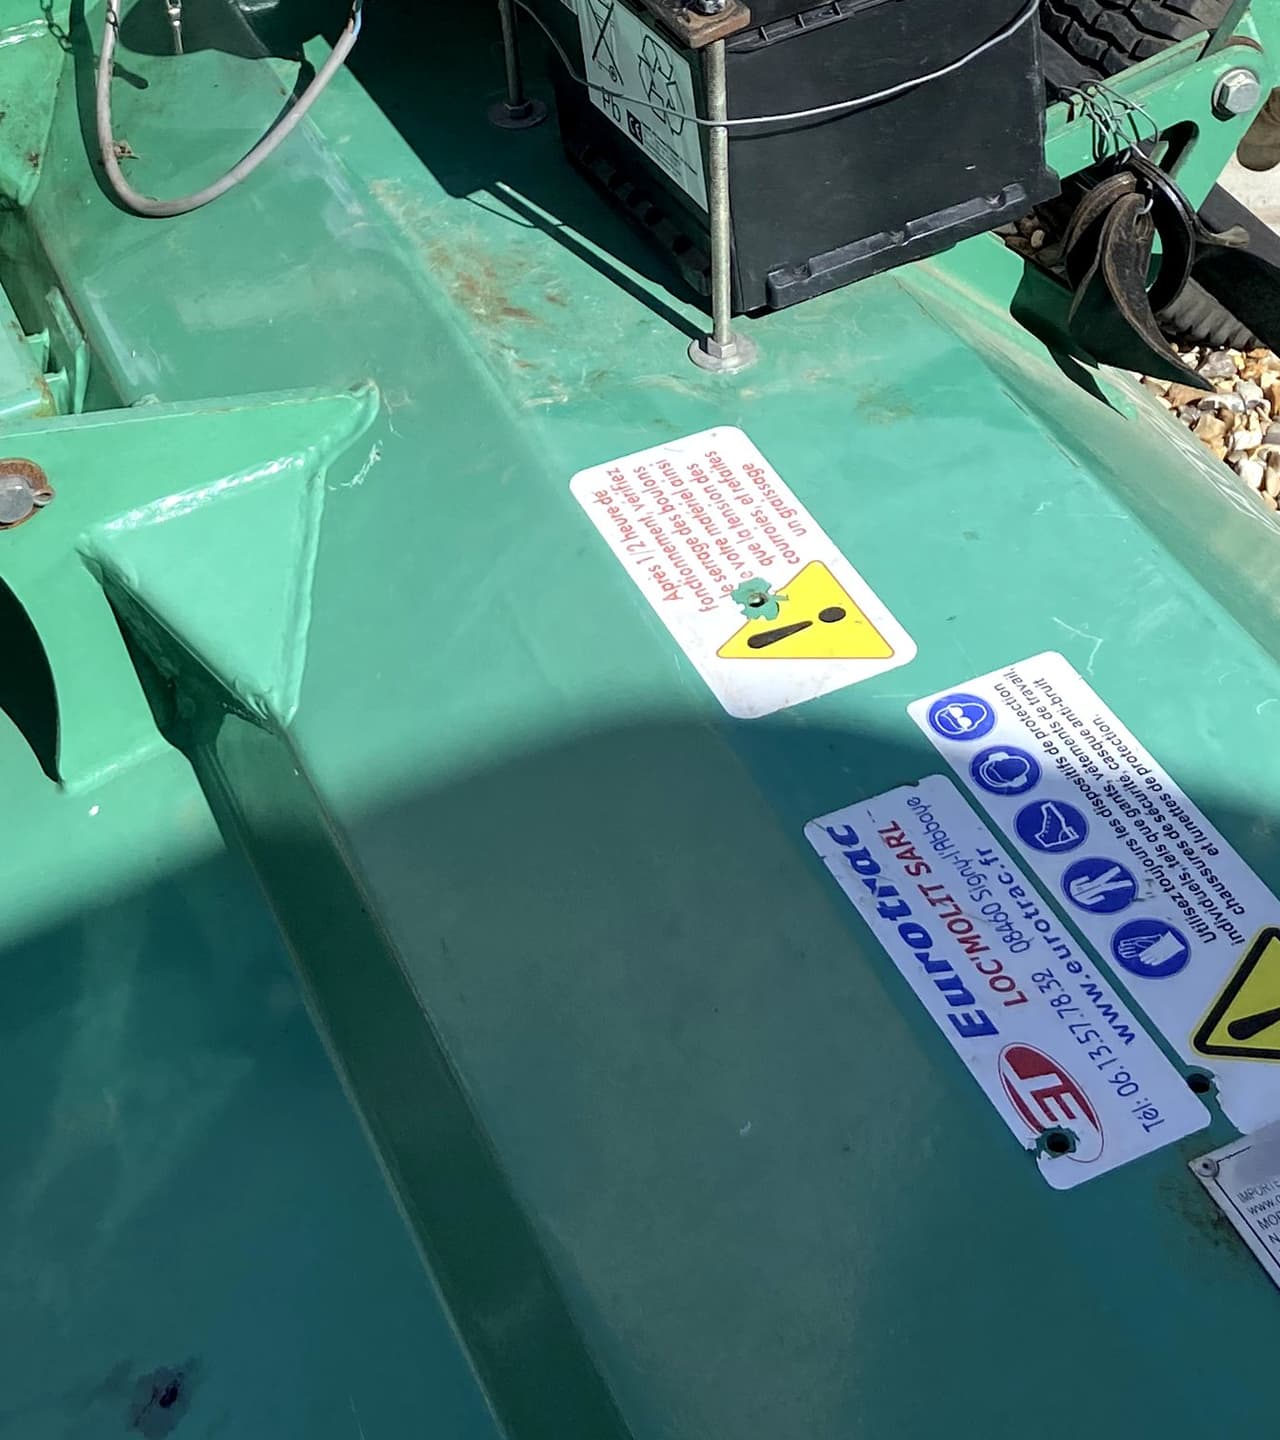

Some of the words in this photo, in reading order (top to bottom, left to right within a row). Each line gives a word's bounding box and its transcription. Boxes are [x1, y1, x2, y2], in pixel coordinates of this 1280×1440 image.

[606, 467, 644, 511] vérifiez
[633, 466, 675, 515] boulons
[649, 458, 684, 487] ainsi
[686, 463, 709, 483] des
[704, 450, 744, 492] refaites
[742, 463, 797, 518] graissage
[591, 489, 613, 505] de
[671, 488, 721, 536] matériel
[703, 484, 743, 529] tension
[733, 493, 754, 505] et
[606, 506, 638, 542] heure
[668, 513, 692, 535] des
[735, 528, 754, 544] la
[750, 505, 800, 564] courroies,
[787, 519, 807, 536] un
[637, 511, 717, 612] fonctionnement,
[685, 537, 726, 582] serrage
[714, 537, 744, 569] votre
[747, 542, 775, 566] que
[647, 564, 683, 601] Après
[718, 583, 734, 599] le
[1003, 667, 1040, 705] travail,
[1032, 677, 1083, 727] anti-bruit
[994, 682, 1049, 739] protection
[1035, 705, 1052, 720] de
[1042, 740, 1059, 755] de
[1049, 721, 1106, 782] vêtements
[1079, 728, 1119, 770] casque
[1092, 714, 1152, 776] protection.
[1056, 756, 1116, 819] dispositifs
[1103, 780, 1141, 818] gants,
[1116, 771, 1166, 824] sécurité,
[1144, 776, 1162, 794] de
[1108, 818, 1129, 839] les
[1133, 818, 1159, 842] que
[1159, 793, 1207, 843] lunettes
[1161, 822, 1180, 839] de
[877, 820, 931, 876] SARL
[907, 796, 991, 901] Signy-l'Abbaye
[1125, 838, 1175, 892] toujours
[1154, 843, 1180, 868] tels
[1200, 842, 1219, 856] et
[1176, 840, 1244, 914] chaussures
[1170, 892, 1216, 943] Utilisez
[1178, 867, 1244, 945] individuels,
[825, 824, 999, 1038] Eurotrac
[918, 884, 1027, 1006] LOC'MOLIT
[976, 848, 1134, 1043] www.eurotrac.fr
[1031, 968, 1138, 1096] 06.13.57.78.32
[1131, 1097, 1164, 1132] Tél:
